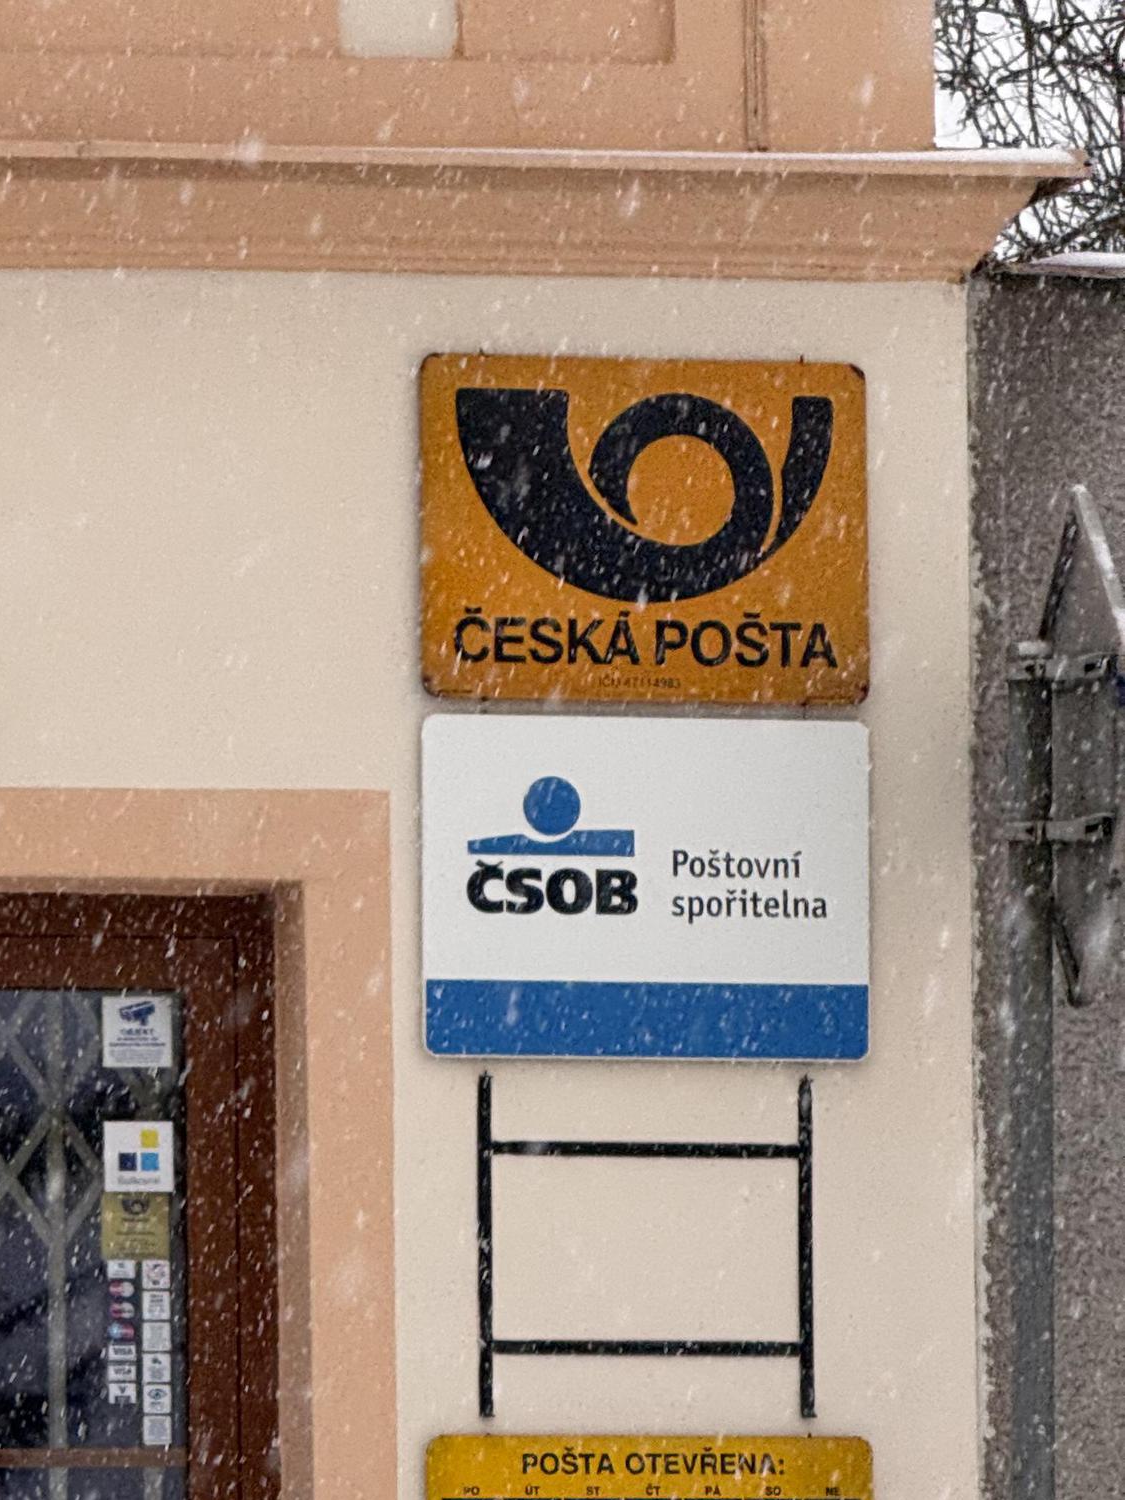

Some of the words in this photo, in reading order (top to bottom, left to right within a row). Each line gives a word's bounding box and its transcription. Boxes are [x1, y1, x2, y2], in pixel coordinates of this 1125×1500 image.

[454, 607, 641, 664] ČESKÁ
[655, 612, 839, 668] POŠTA
[671, 849, 802, 879] Poštovní
[466, 860, 638, 915] ČSOB
[671, 889, 828, 925] spořitelna
[521, 1447, 614, 1475] POŠTA
[625, 1447, 786, 1477] OTEVŘENA:
[463, 1486, 480, 1496] PO
[586, 1486, 601, 1496] ST
[646, 1484, 661, 1496] ČT
[765, 1486, 782, 1496] SO
[826, 1487, 840, 1497] NE
